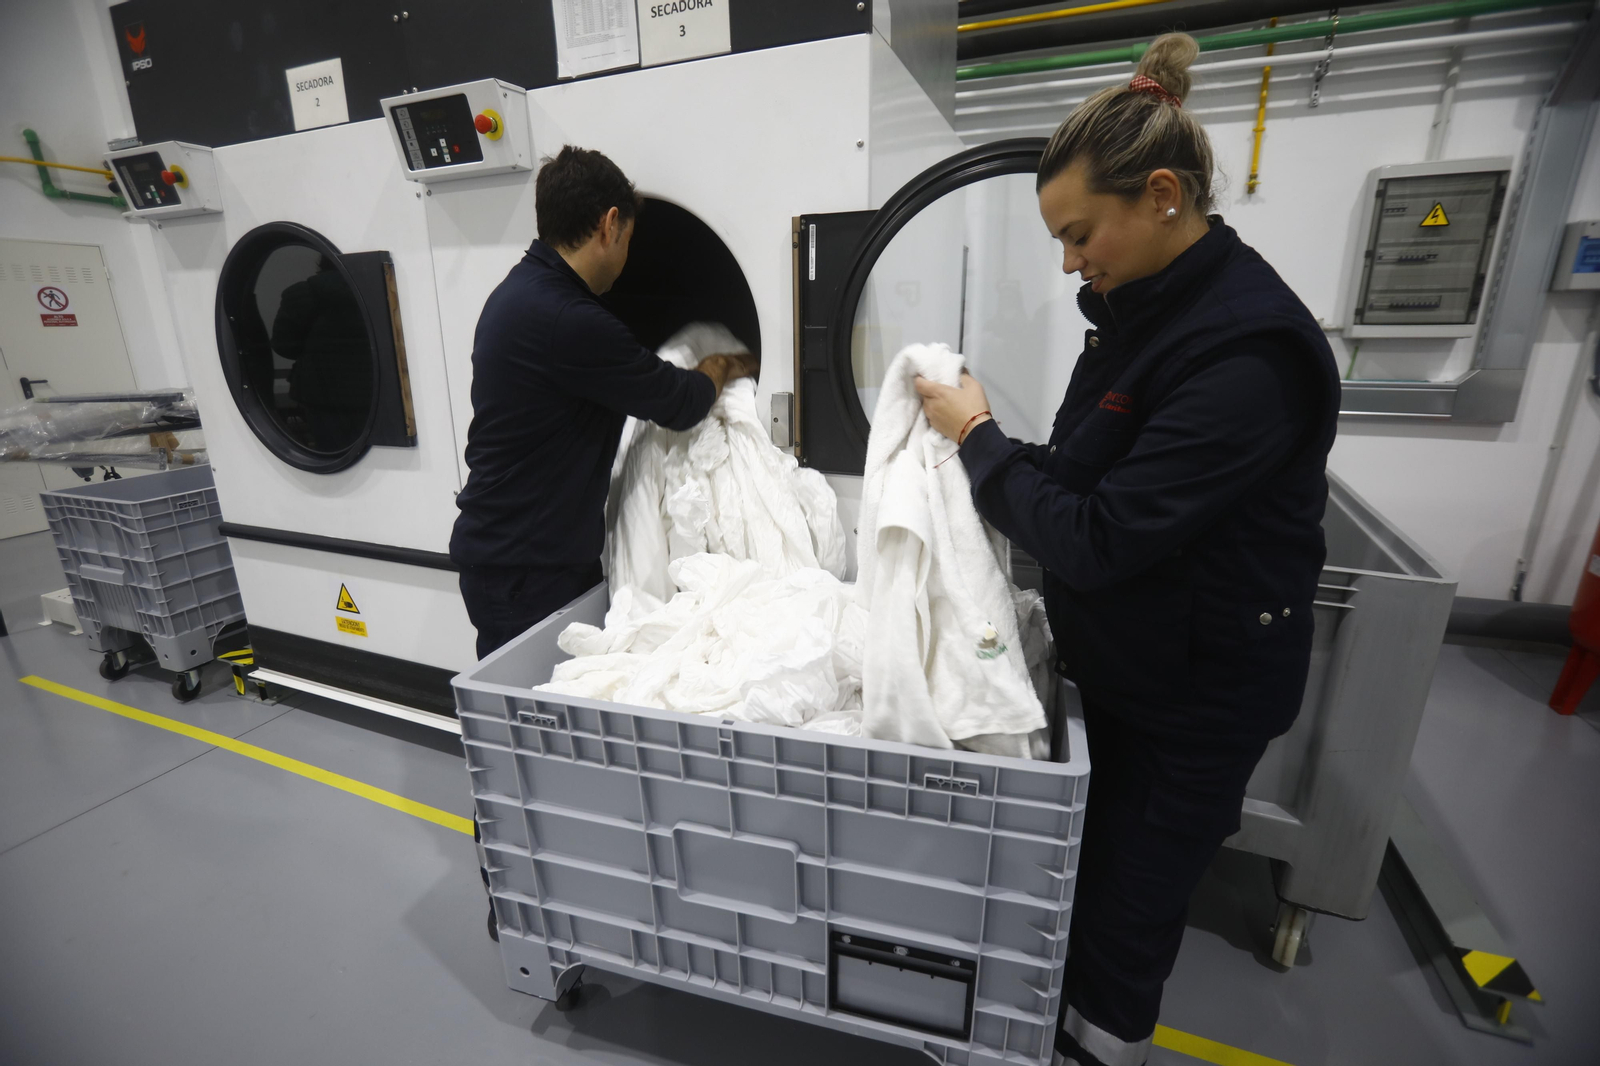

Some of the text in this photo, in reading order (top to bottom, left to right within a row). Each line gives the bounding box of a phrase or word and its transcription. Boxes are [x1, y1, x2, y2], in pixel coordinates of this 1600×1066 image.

[651, 0, 713, 19] SECADORA
[679, 24, 686, 37] 3
[132, 58, 153, 71] IPSO
[296, 75, 334, 92] SECADORA
[315, 97, 320, 107] 2
